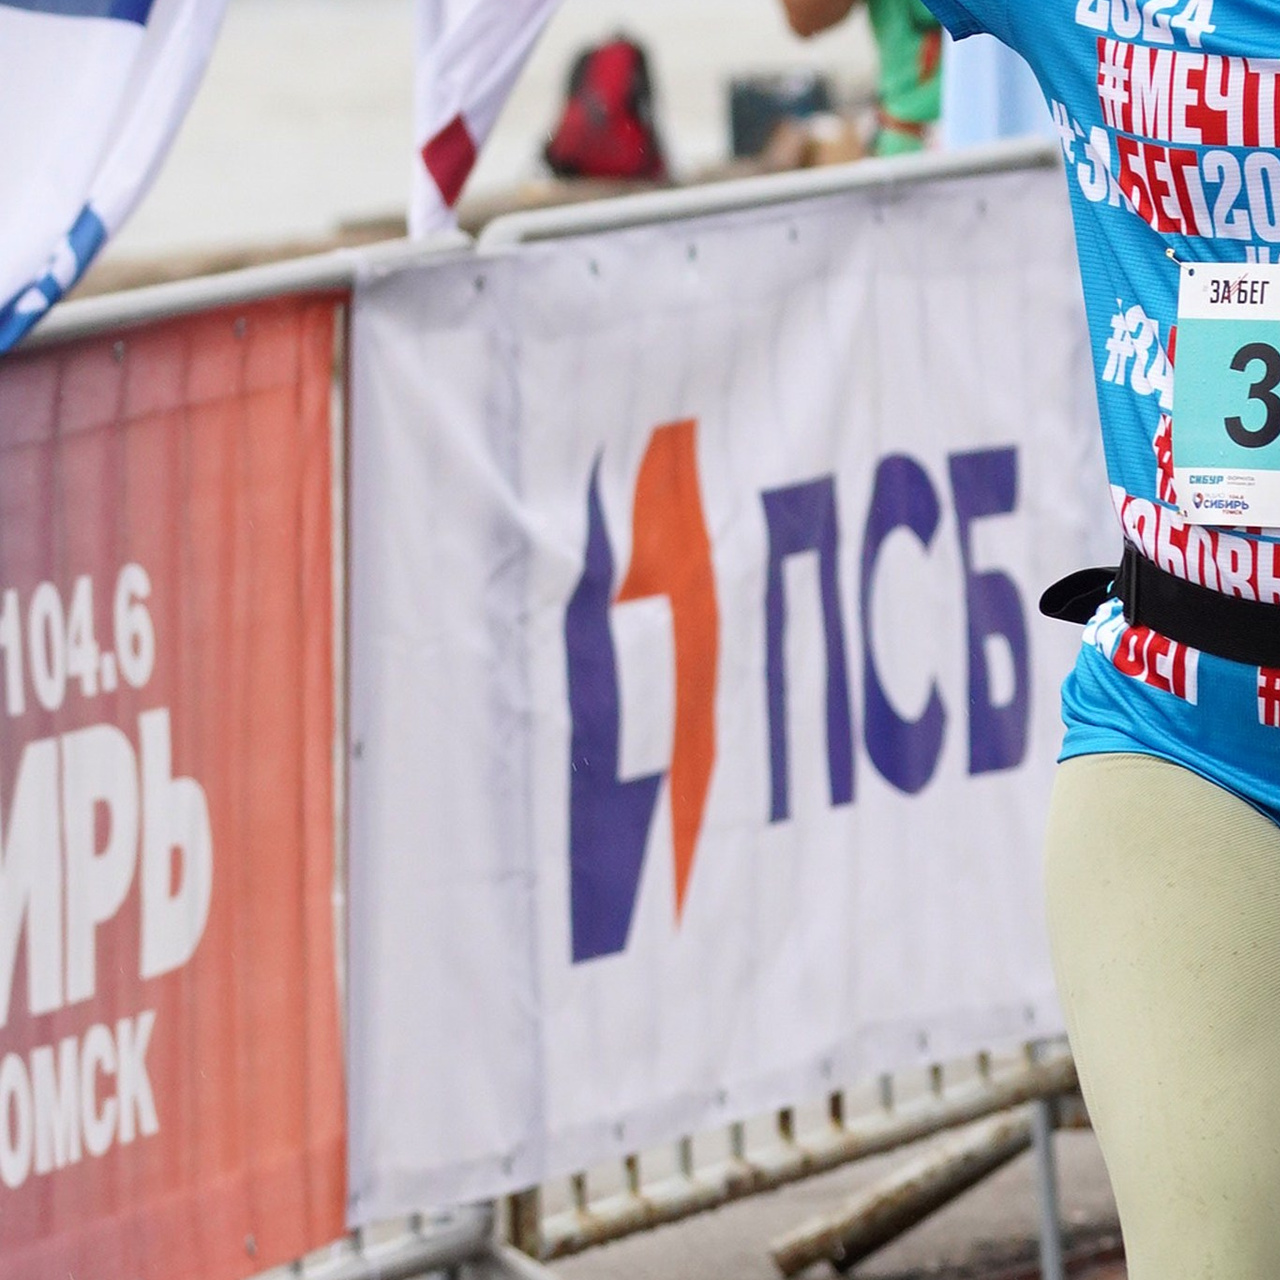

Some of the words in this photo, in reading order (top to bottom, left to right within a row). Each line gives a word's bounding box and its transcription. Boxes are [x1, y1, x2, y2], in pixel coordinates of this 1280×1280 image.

[1203, 499, 1250, 511] СИБИРЬ
[760, 444, 1031, 825] ПСБ
[0, 1008, 160, 1190] ОМСК
